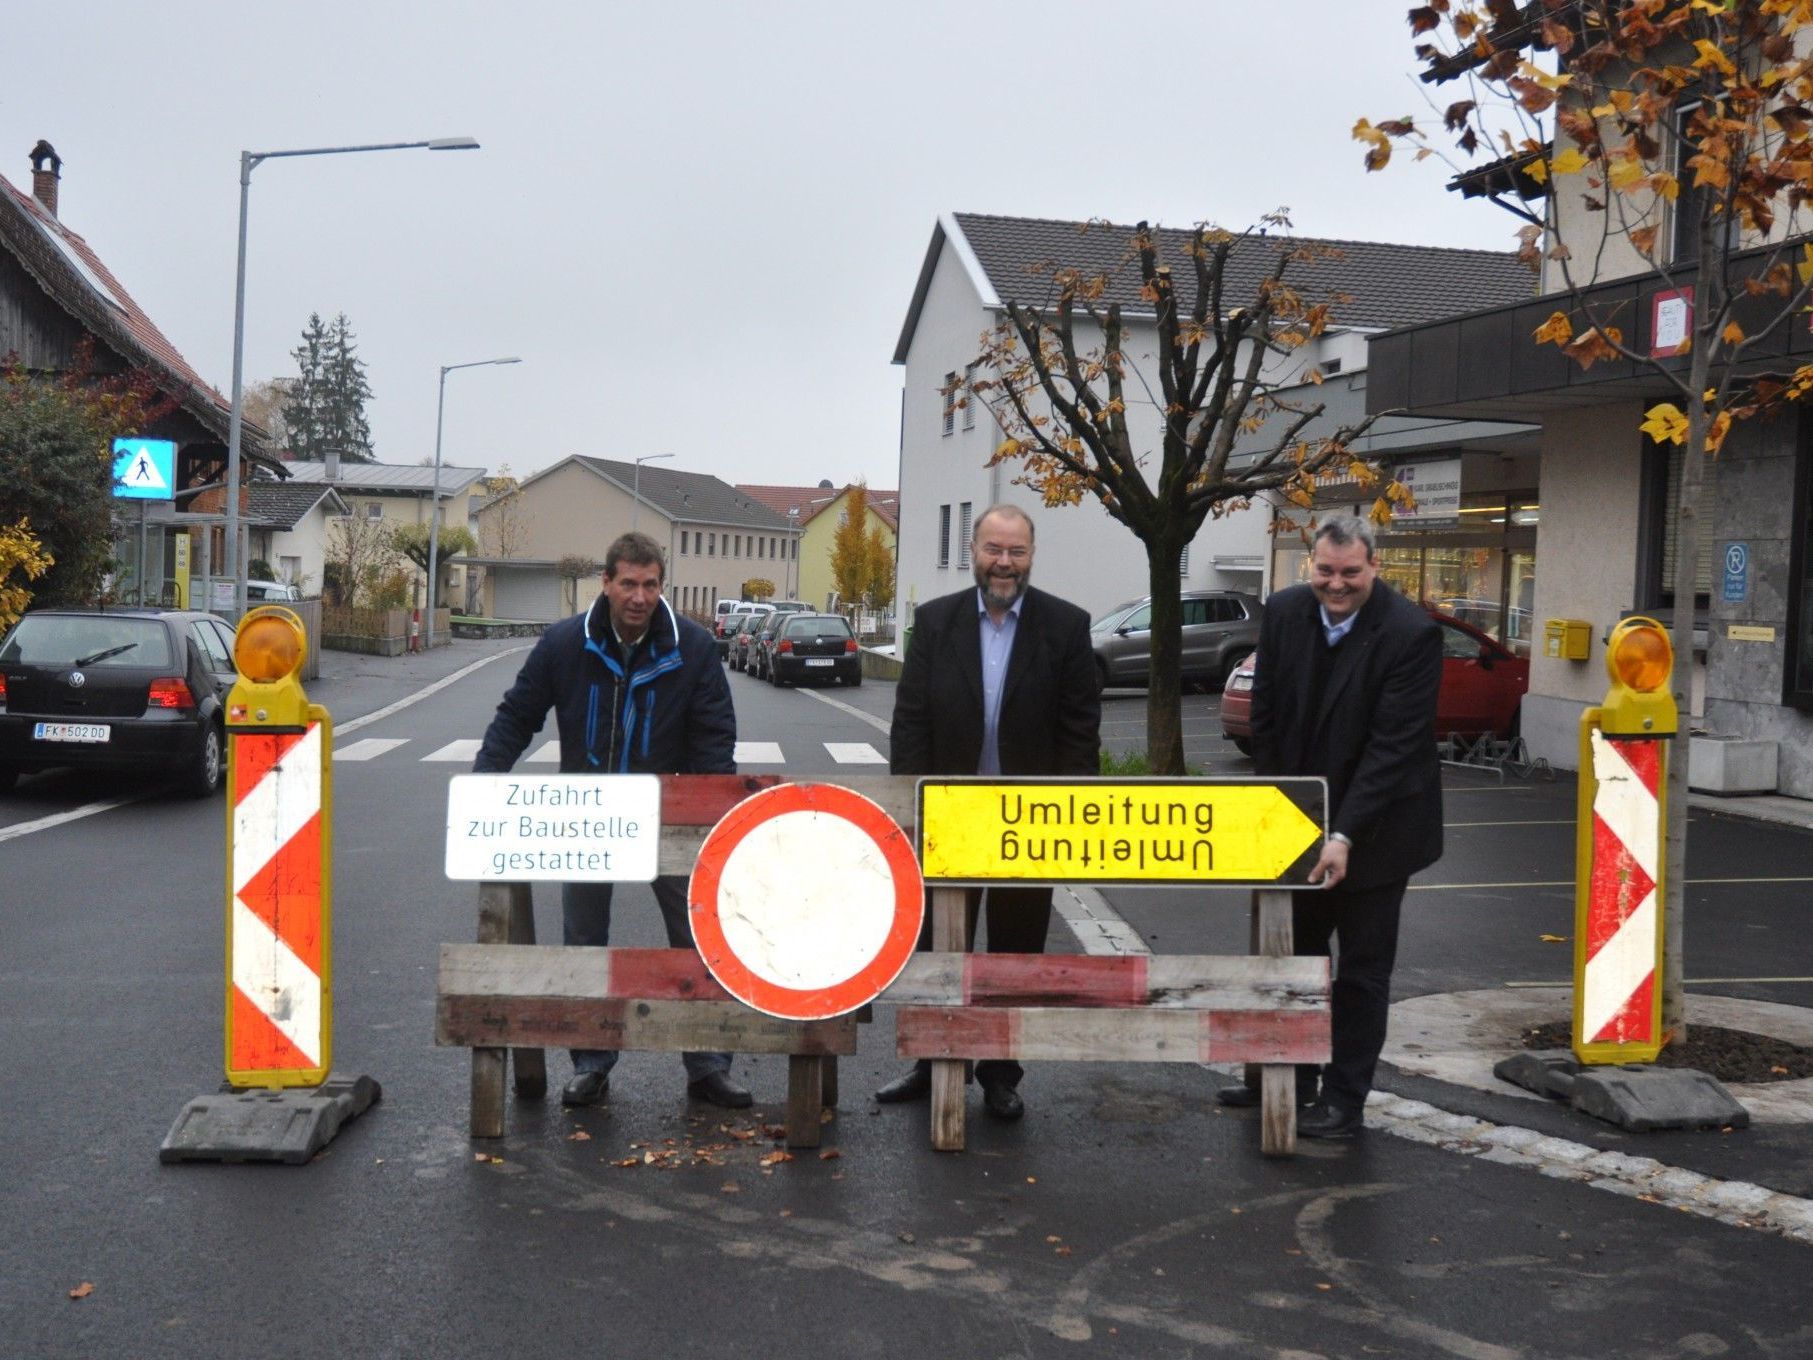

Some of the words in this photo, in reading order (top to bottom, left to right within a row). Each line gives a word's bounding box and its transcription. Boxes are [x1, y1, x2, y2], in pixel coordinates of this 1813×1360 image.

[46, 725, 60, 736] FK
[68, 726, 89, 737] 502
[506, 784, 603, 806] Zufahrt
[1001, 794, 1213, 834] Umleitung
[468, 821, 508, 837] zur
[519, 816, 639, 838] Baustelle
[1001, 830, 1213, 870] Umleitung
[493, 850, 613, 875] gestattet
